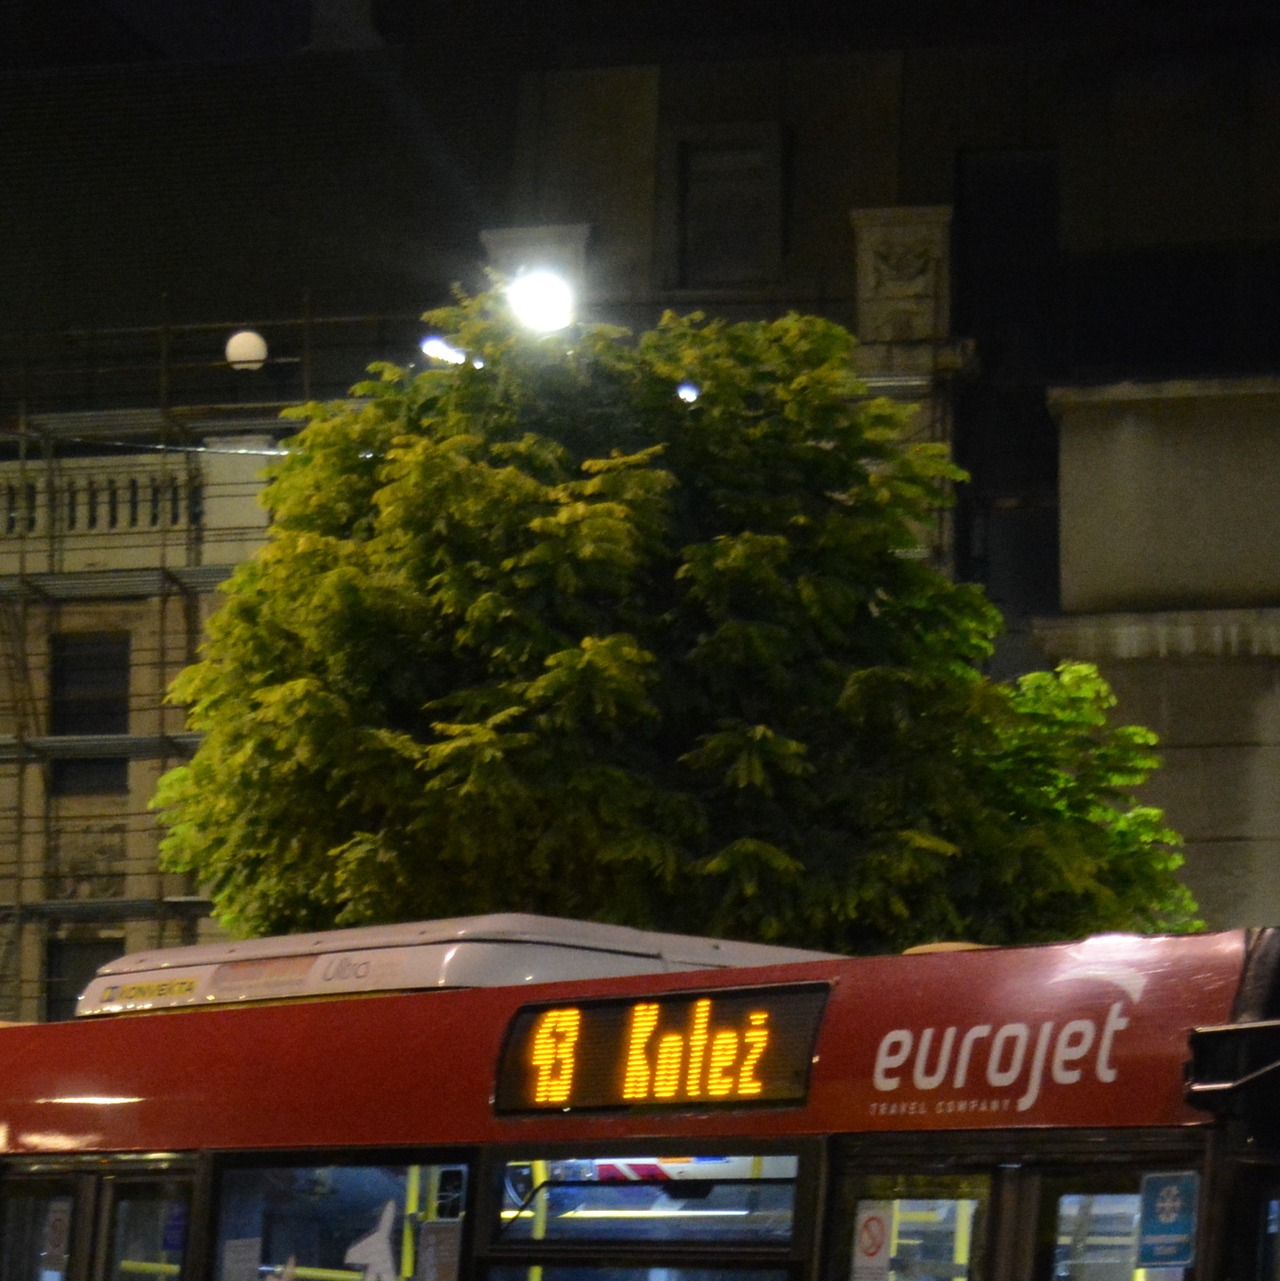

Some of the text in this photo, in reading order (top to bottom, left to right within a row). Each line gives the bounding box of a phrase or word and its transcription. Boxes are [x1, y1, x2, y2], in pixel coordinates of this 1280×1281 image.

[532, 1007, 580, 1102] 43
[872, 1001, 1130, 1112] eurojet
[869, 1099, 1012, 1116] TRAVEL COMPANY
